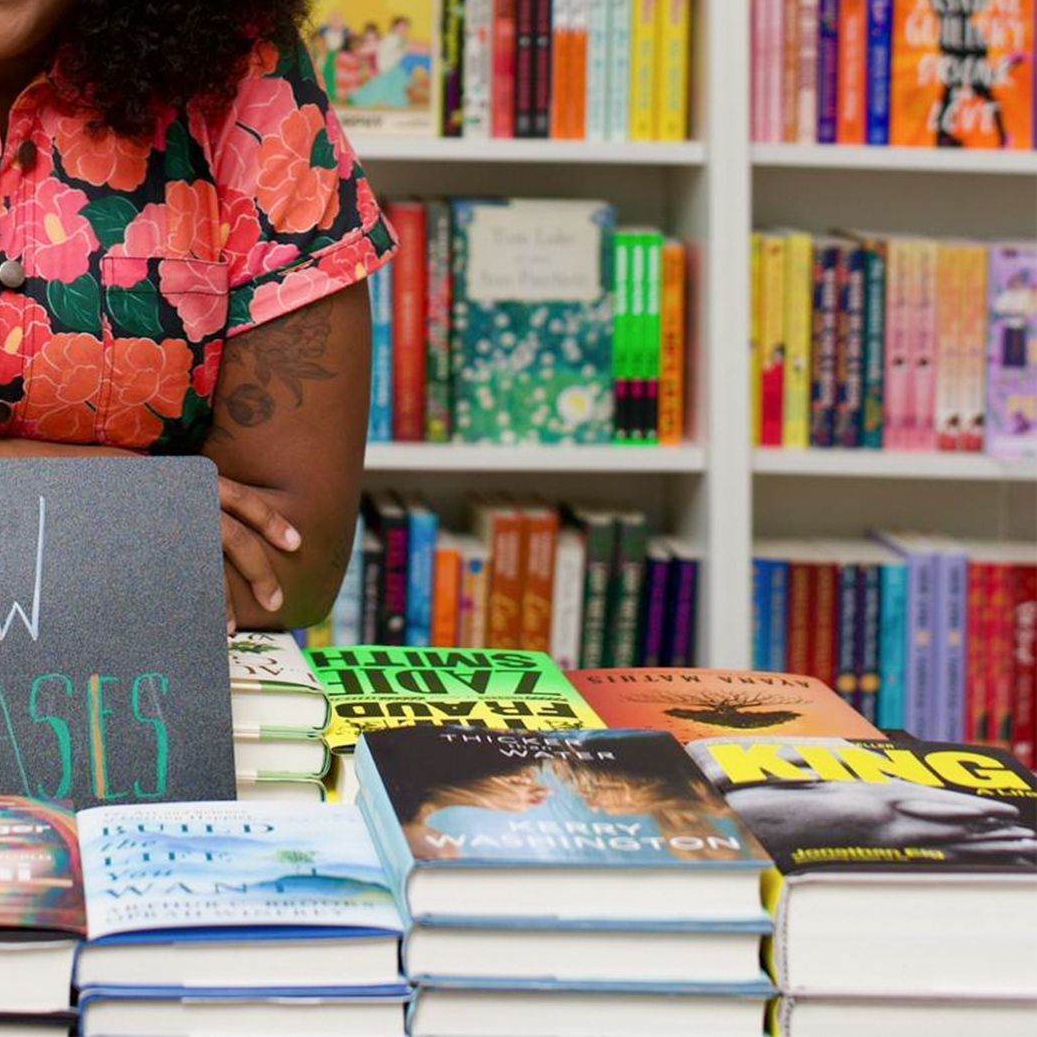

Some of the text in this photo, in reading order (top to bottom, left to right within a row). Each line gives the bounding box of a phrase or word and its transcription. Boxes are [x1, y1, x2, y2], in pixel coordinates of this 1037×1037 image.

[309, 650, 539, 668] SMITH
[320, 667, 562, 697] ZADIE
[587, 674, 812, 689] AYANA MATHIS
[334, 700, 579, 720] FRAUD
[439, 733, 584, 749] THICKER
[498, 747, 617, 760] WATER
[707, 743, 1031, 790] KING
[102, 823, 275, 836] BUILD
[505, 820, 644, 836] KERRY
[425, 833, 742, 852] WASHINGTON
[791, 846, 902, 864] Jonathan
[107, 880, 288, 899] WANT
